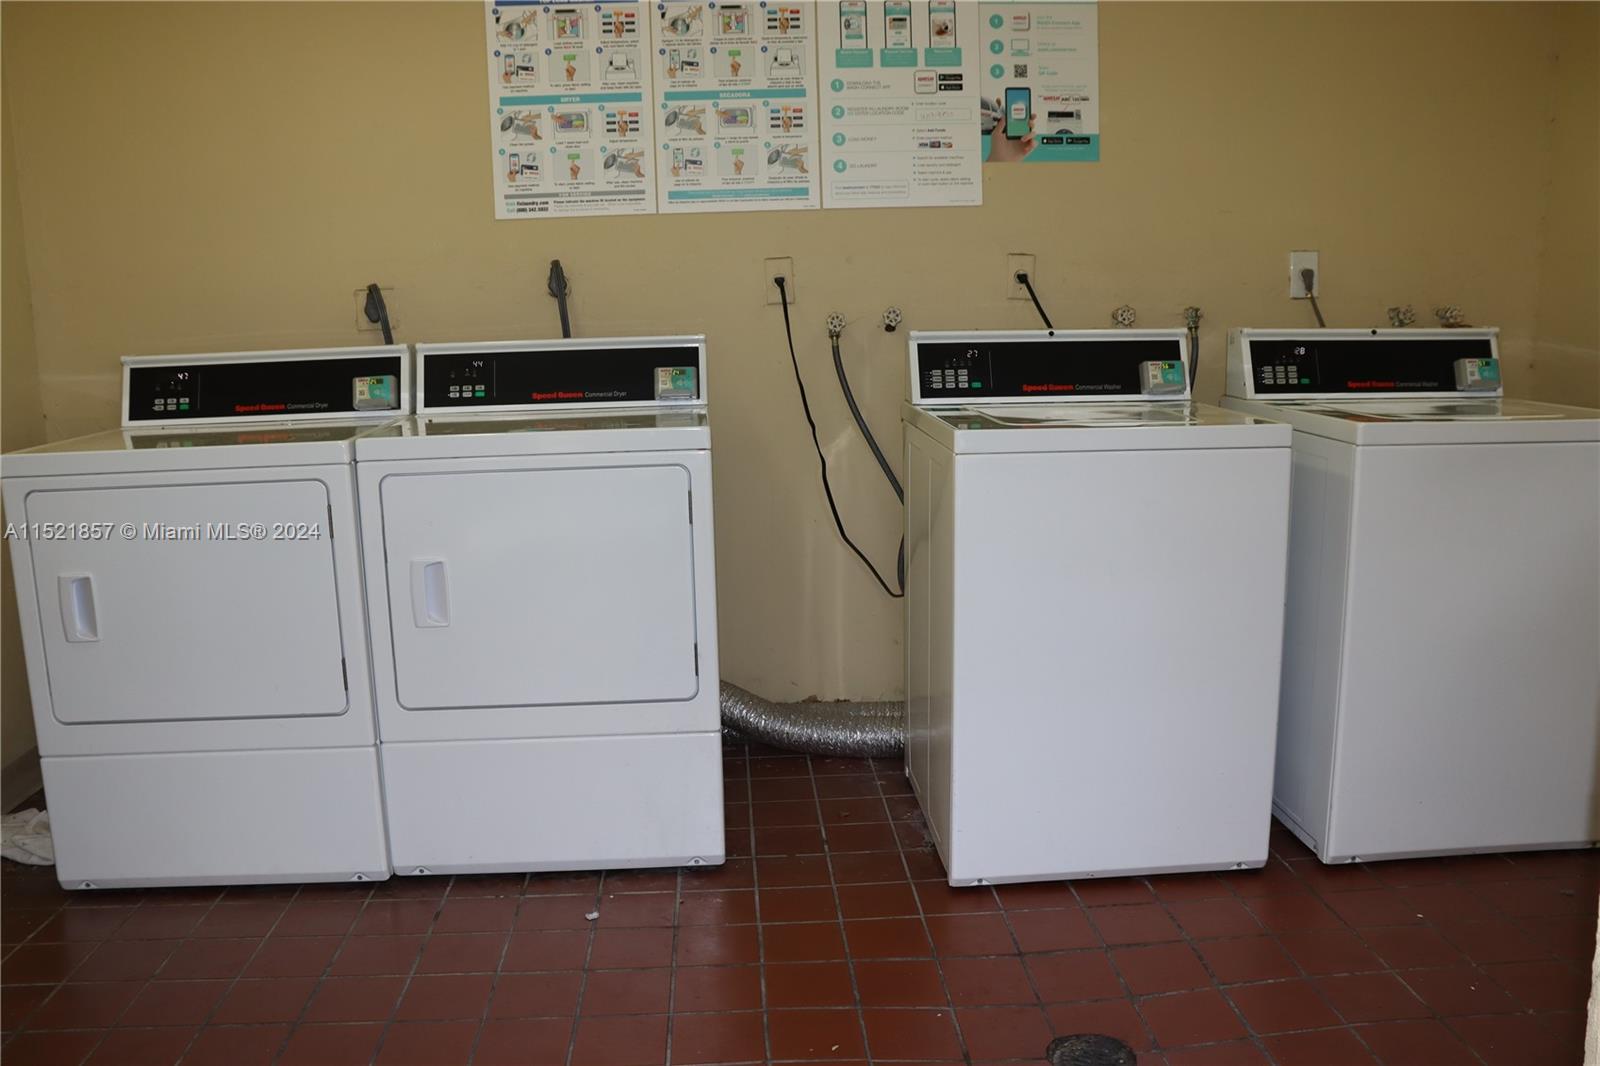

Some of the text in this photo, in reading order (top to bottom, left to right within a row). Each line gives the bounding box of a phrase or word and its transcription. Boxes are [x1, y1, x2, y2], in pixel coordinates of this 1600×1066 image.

[834, 81, 839, 89] 1
[834, 107, 841, 116] 2
[835, 135, 842, 144] 3
[836, 161, 843, 170] 4
[967, 350, 978, 358] 27
[1294, 347, 1306, 355] 28
[472, 360, 484, 368] 44
[177, 372, 189, 381] 47
[1022, 384, 1048, 392] Speed
[1048, 383, 1073, 391] Queen
[1347, 380, 1370, 388] Speed
[532, 389, 627, 400] Speed Queen Commercial Dryer
[235, 401, 329, 412] Speed Queen Commercial Dryer
